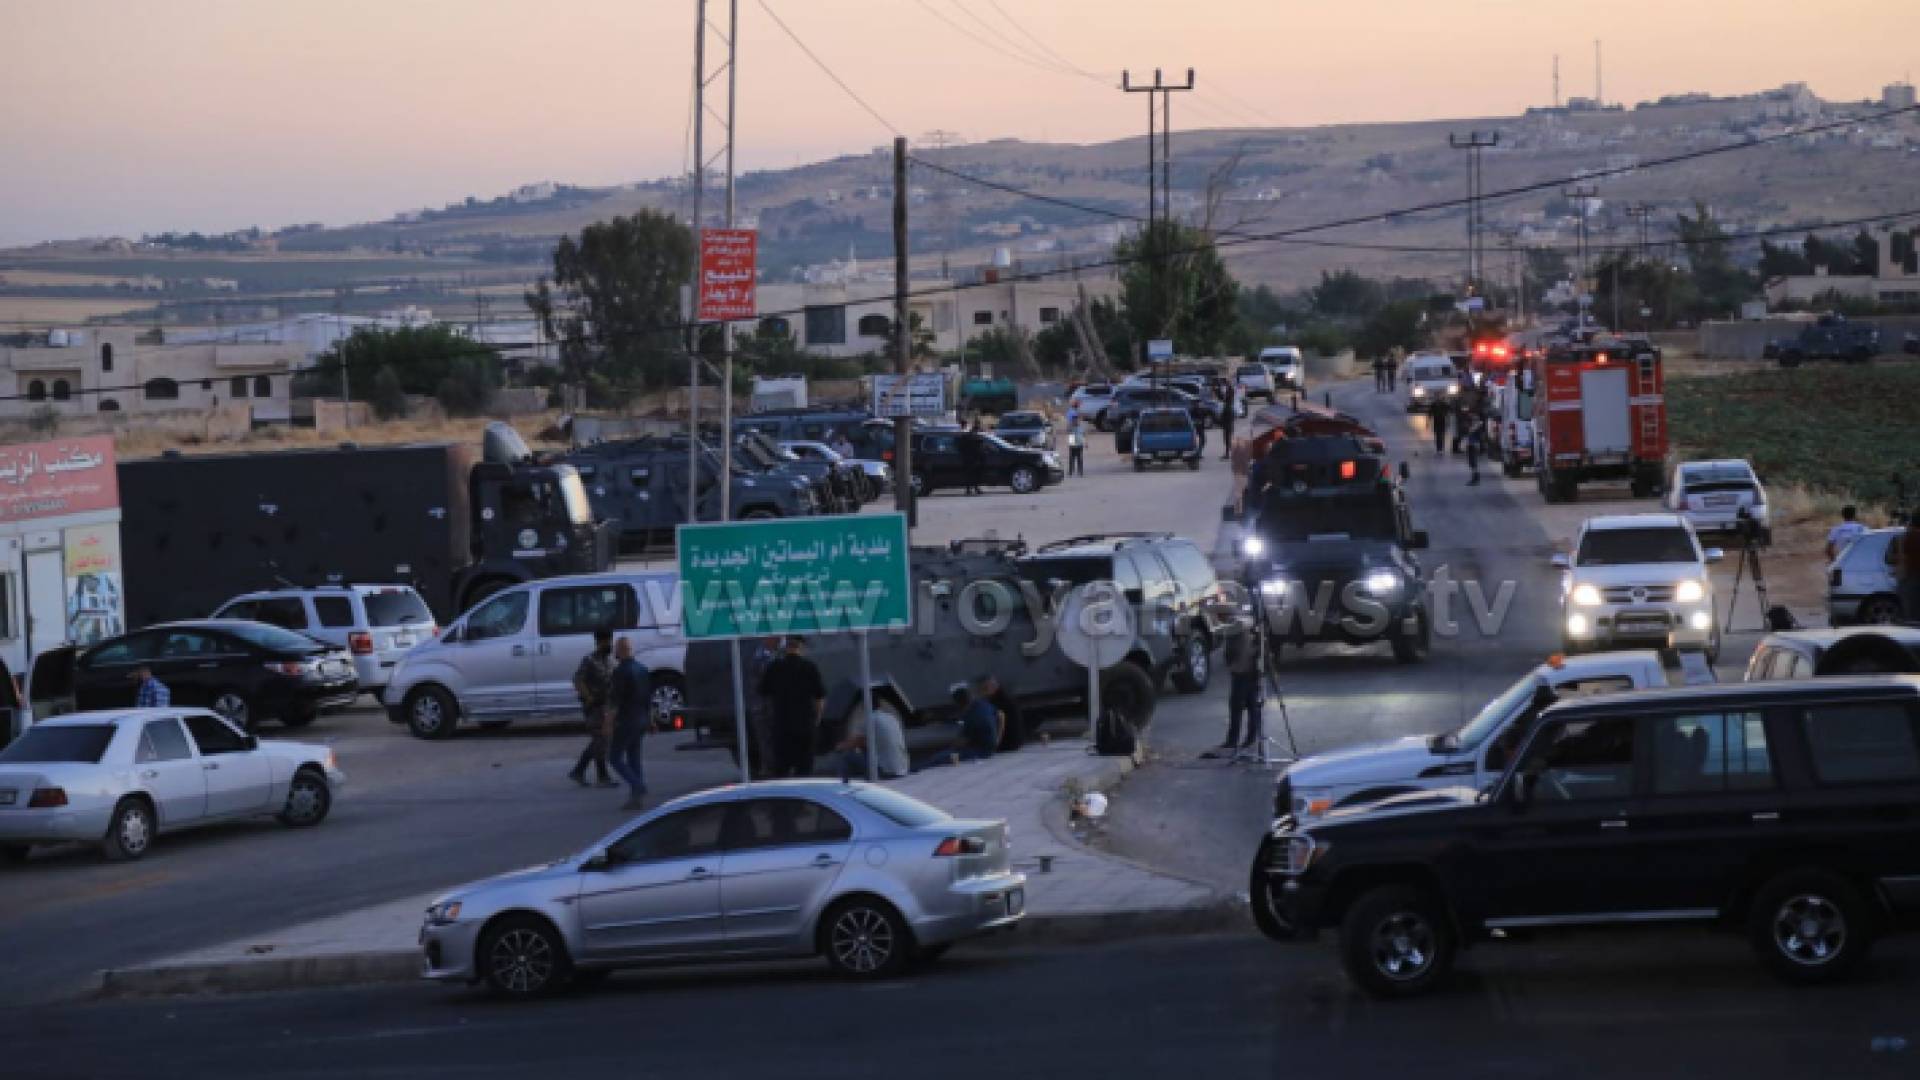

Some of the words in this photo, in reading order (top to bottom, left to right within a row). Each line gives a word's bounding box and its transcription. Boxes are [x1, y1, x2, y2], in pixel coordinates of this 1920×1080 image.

[44, 446, 104, 480] مكتب
[690, 544, 757, 574] الجديدة
[761, 539, 825, 570] البساتين
[848, 533, 892, 563] بلدية
